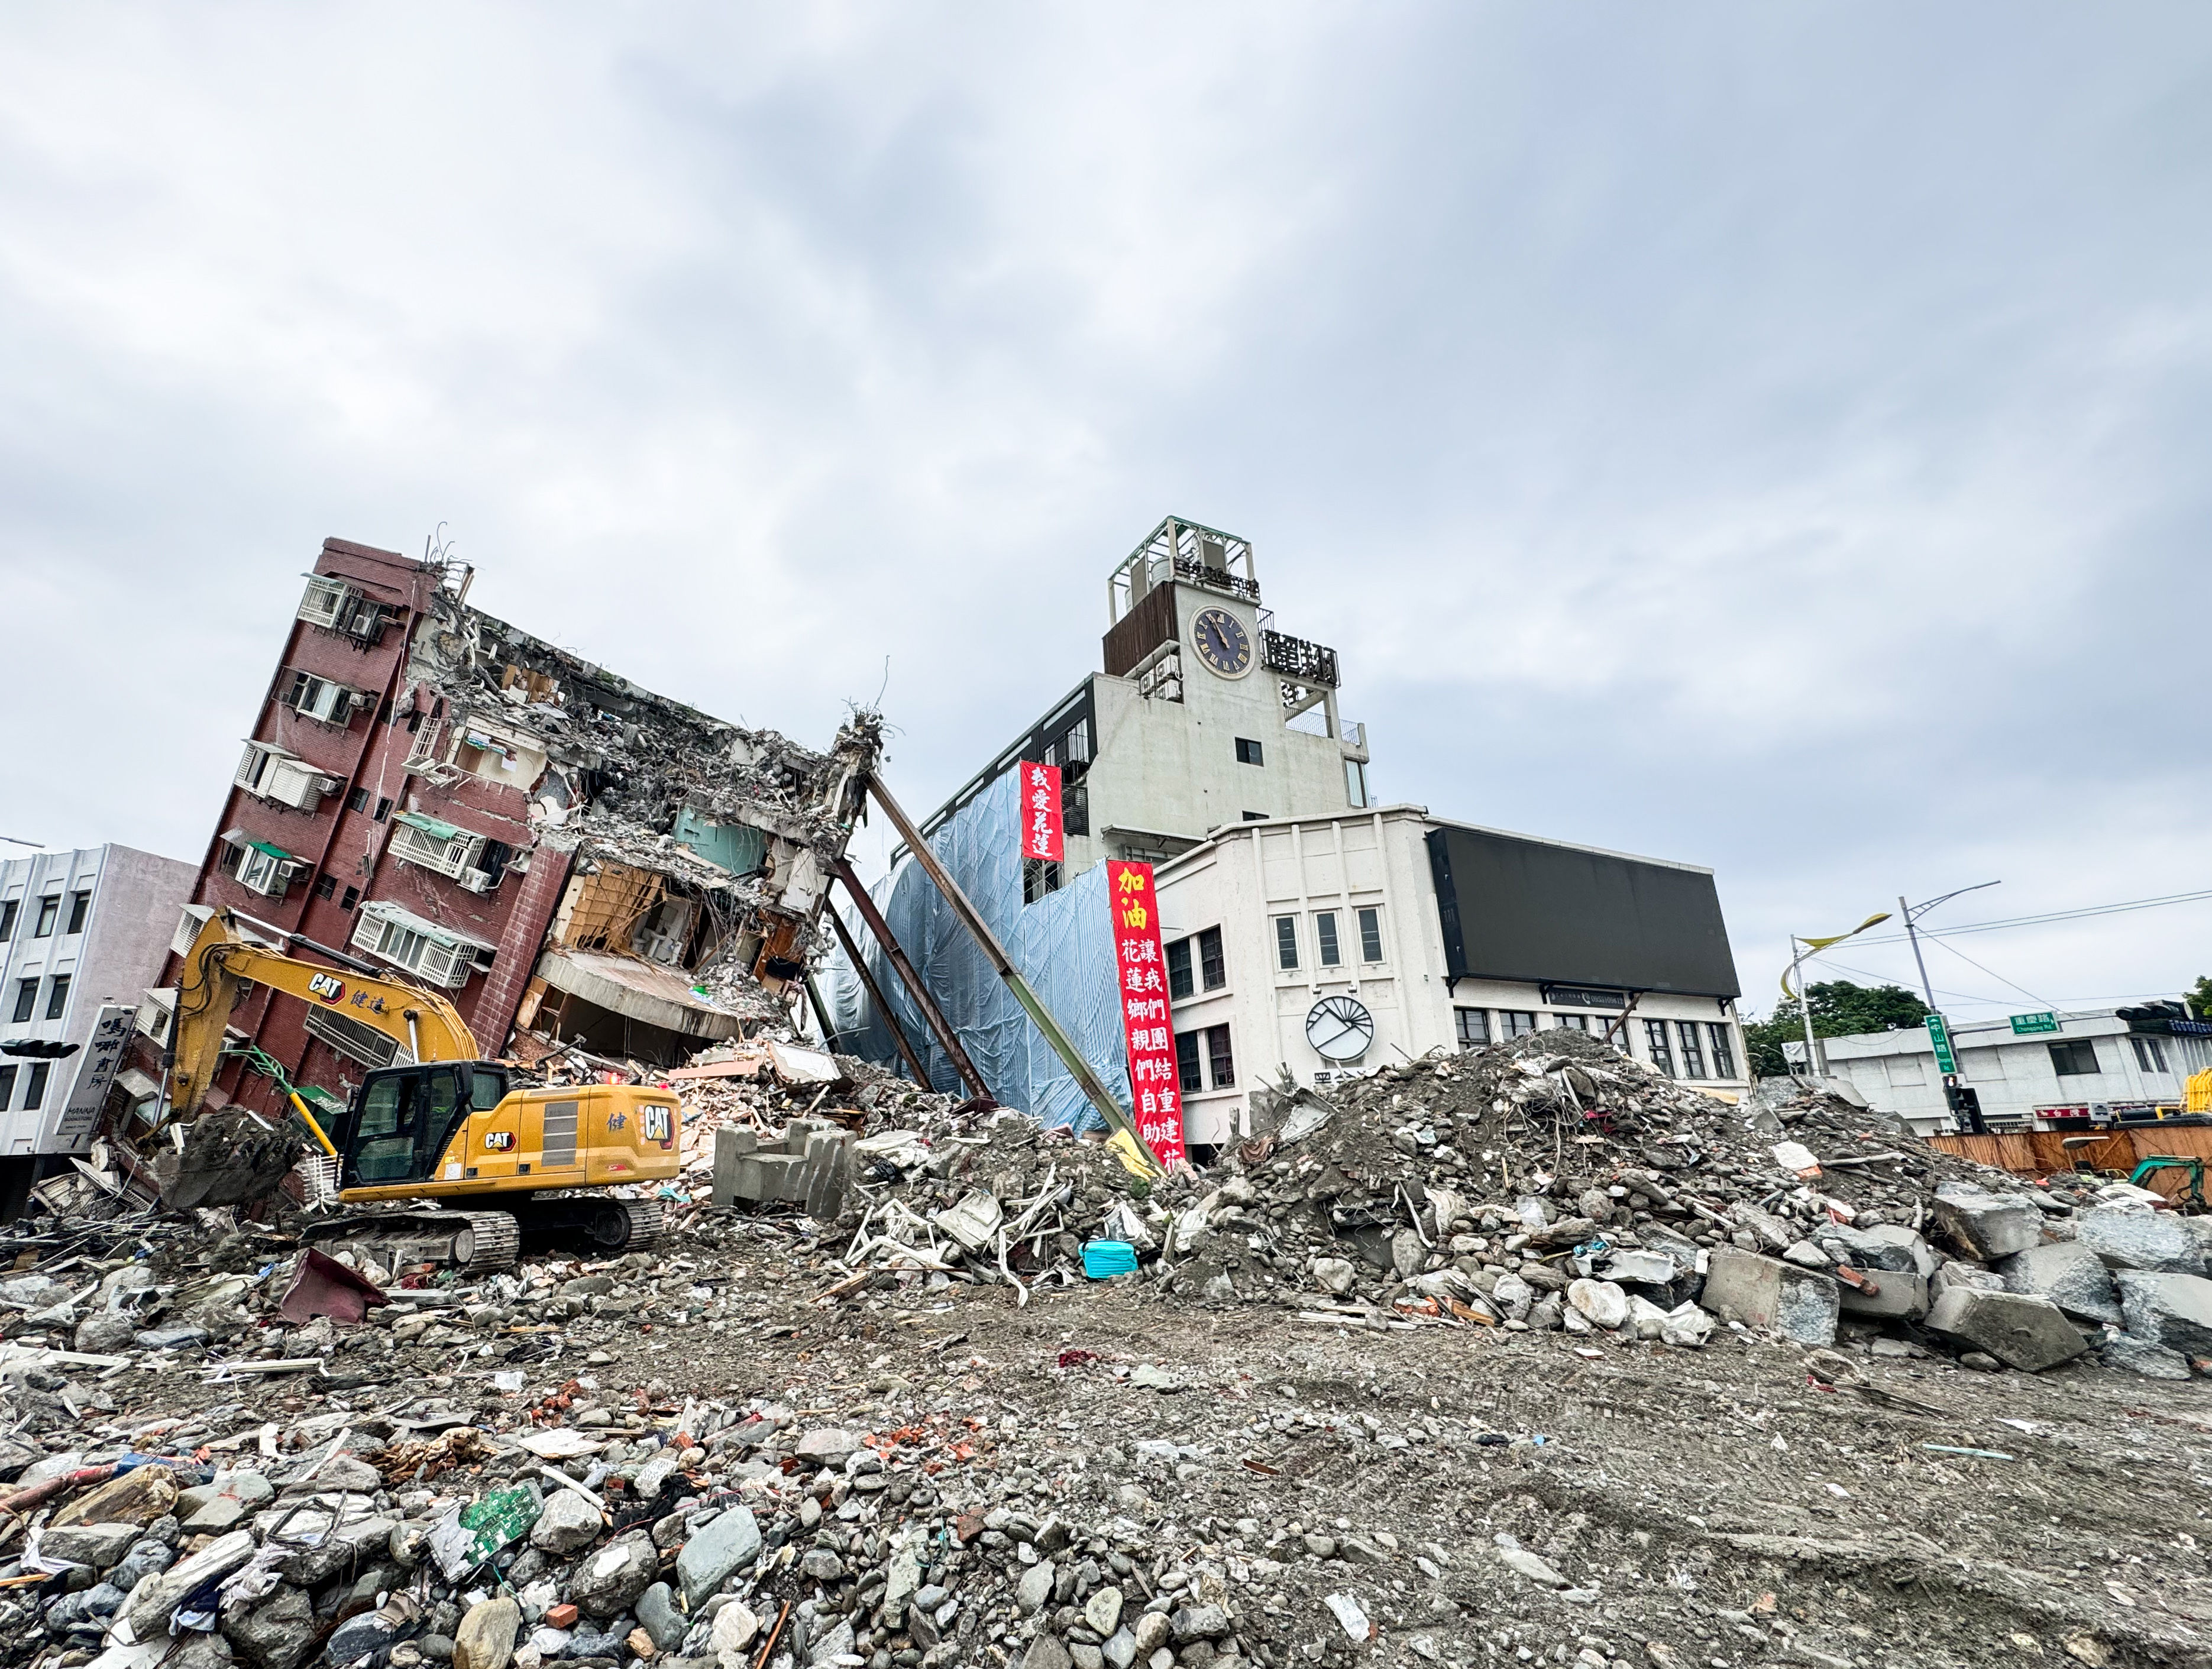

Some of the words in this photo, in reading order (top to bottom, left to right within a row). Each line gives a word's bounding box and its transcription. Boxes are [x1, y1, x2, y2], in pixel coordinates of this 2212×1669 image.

[1031, 766, 1053, 857] 我愛花蓮
[1118, 867, 1147, 930] 加油
[309, 972, 342, 998] CAT
[2014, 1013, 2051, 1026] 重慶路
[1930, 1023, 1948, 1053] 中山路
[67, 1106, 96, 1115] MANNA
[645, 1105, 669, 1140] CAT
[485, 1132, 509, 1149] CAT
